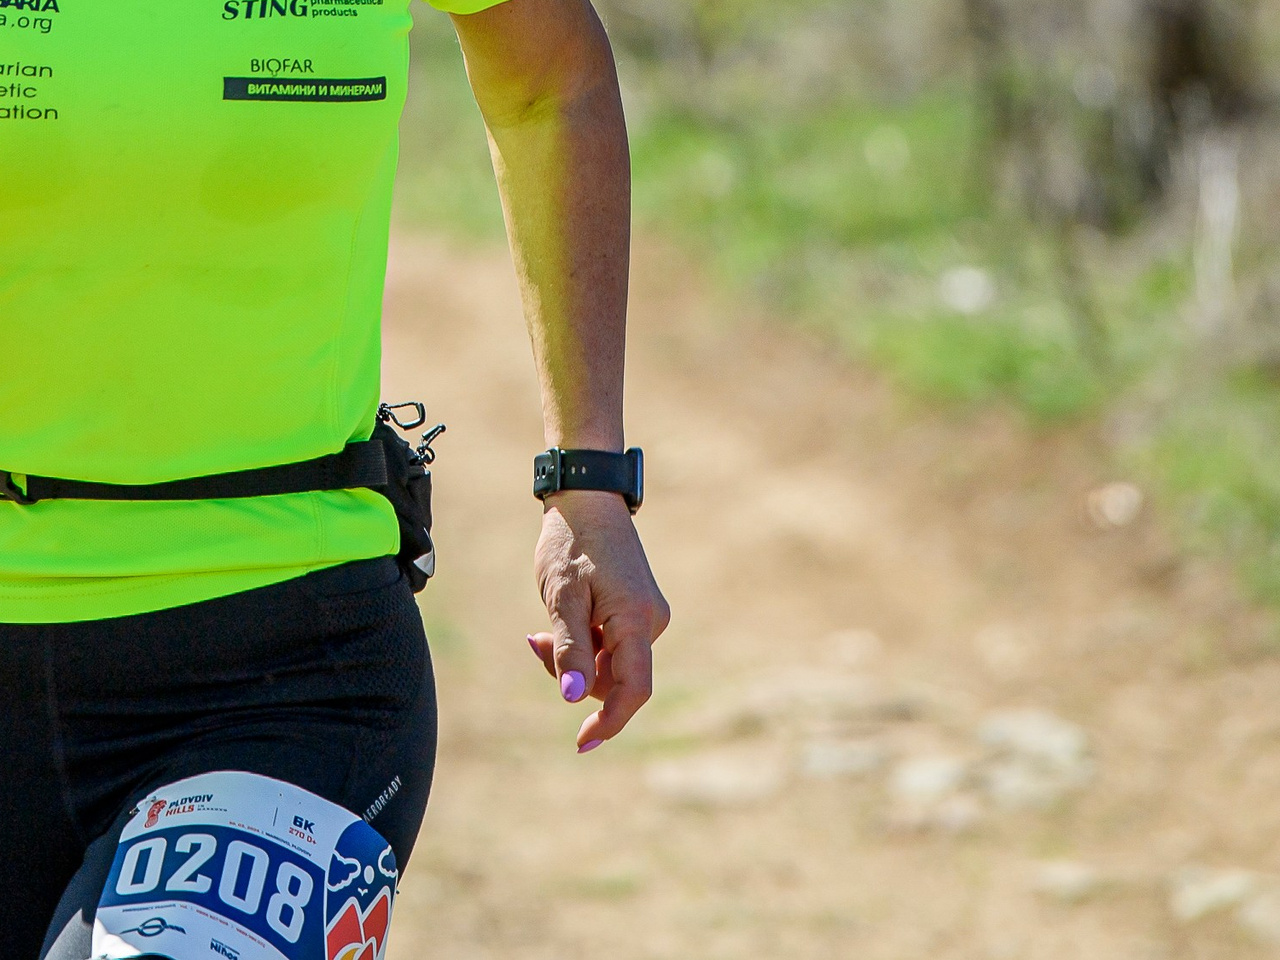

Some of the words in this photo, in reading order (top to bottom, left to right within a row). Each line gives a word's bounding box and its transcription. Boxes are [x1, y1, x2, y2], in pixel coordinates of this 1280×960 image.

[311, 7, 358, 18] products
[250, 58, 314, 74] BIOFAR
[247, 83, 316, 96] ВИТАМИНИ
[318, 84, 328, 96] И
[329, 83, 382, 96] МИНЕРАЛИ
[168, 794, 214, 809] PLOVDIV
[362, 775, 402, 824] AEROREADY
[165, 804, 195, 817] HILLS
[292, 815, 316, 835] 6K
[288, 826, 306, 840] 270
[115, 833, 314, 944] 0208
